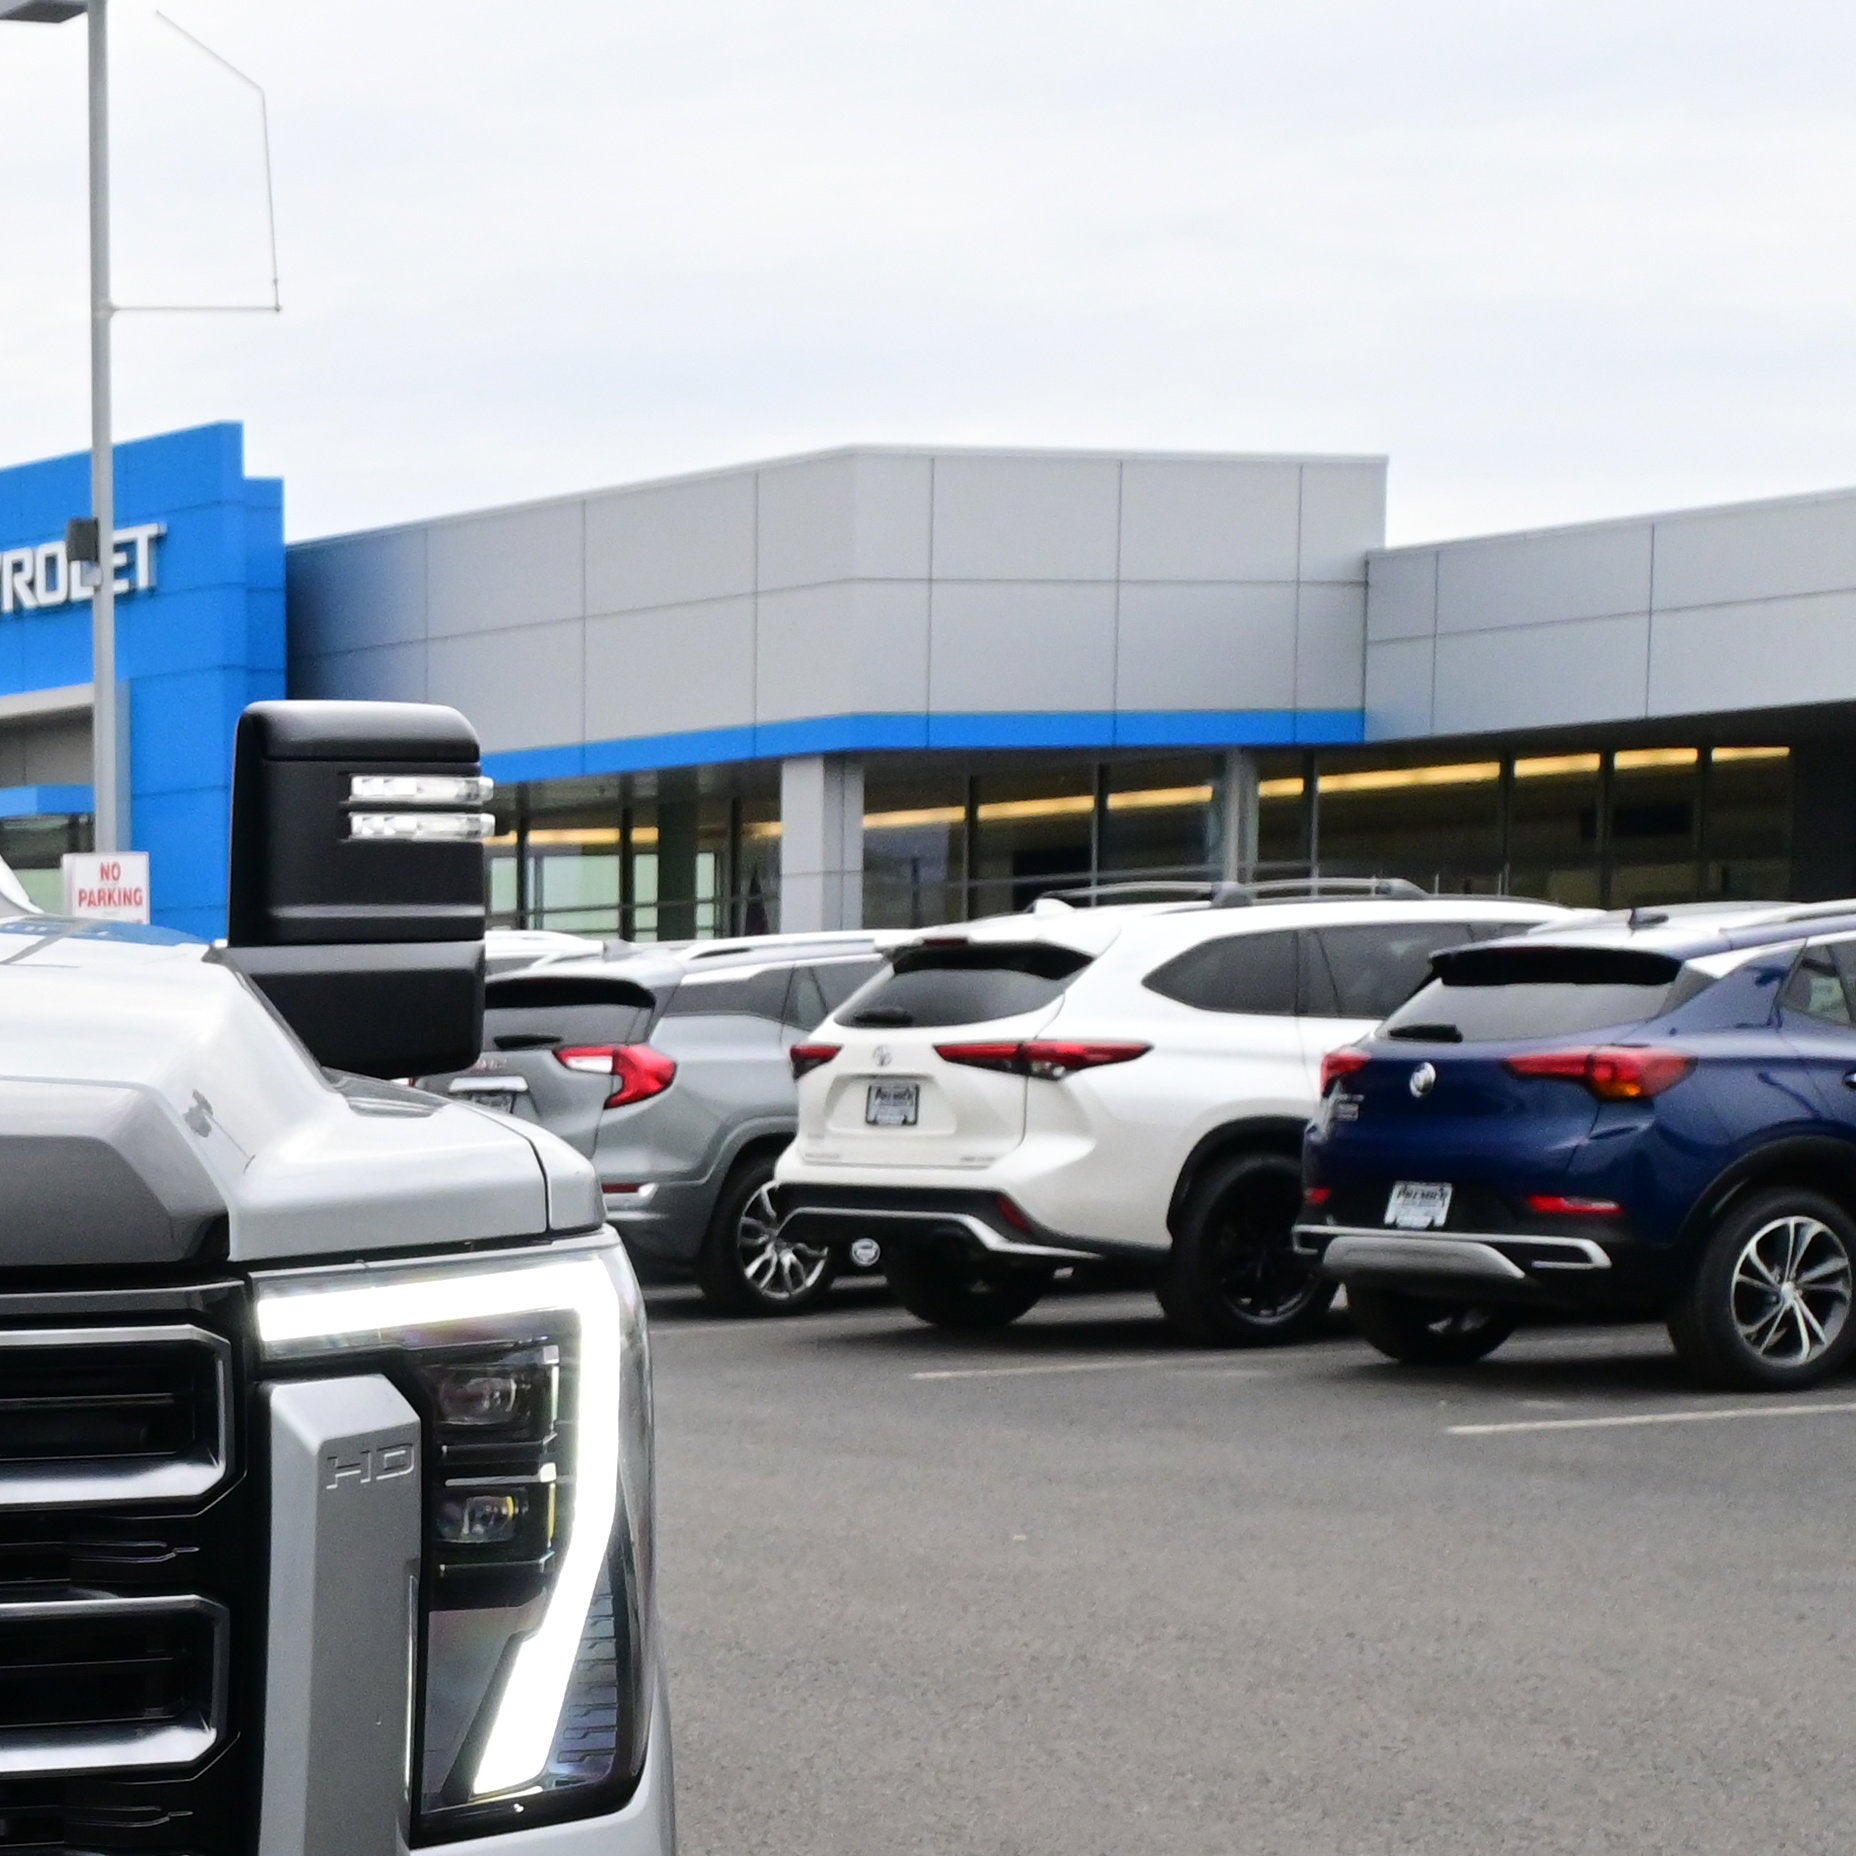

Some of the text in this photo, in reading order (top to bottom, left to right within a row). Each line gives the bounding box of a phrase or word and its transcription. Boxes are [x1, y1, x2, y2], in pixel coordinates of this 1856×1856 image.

[100, 861, 122, 882] NO
[78, 886, 144, 908] PARKING
[324, 1442, 416, 1491] HD
